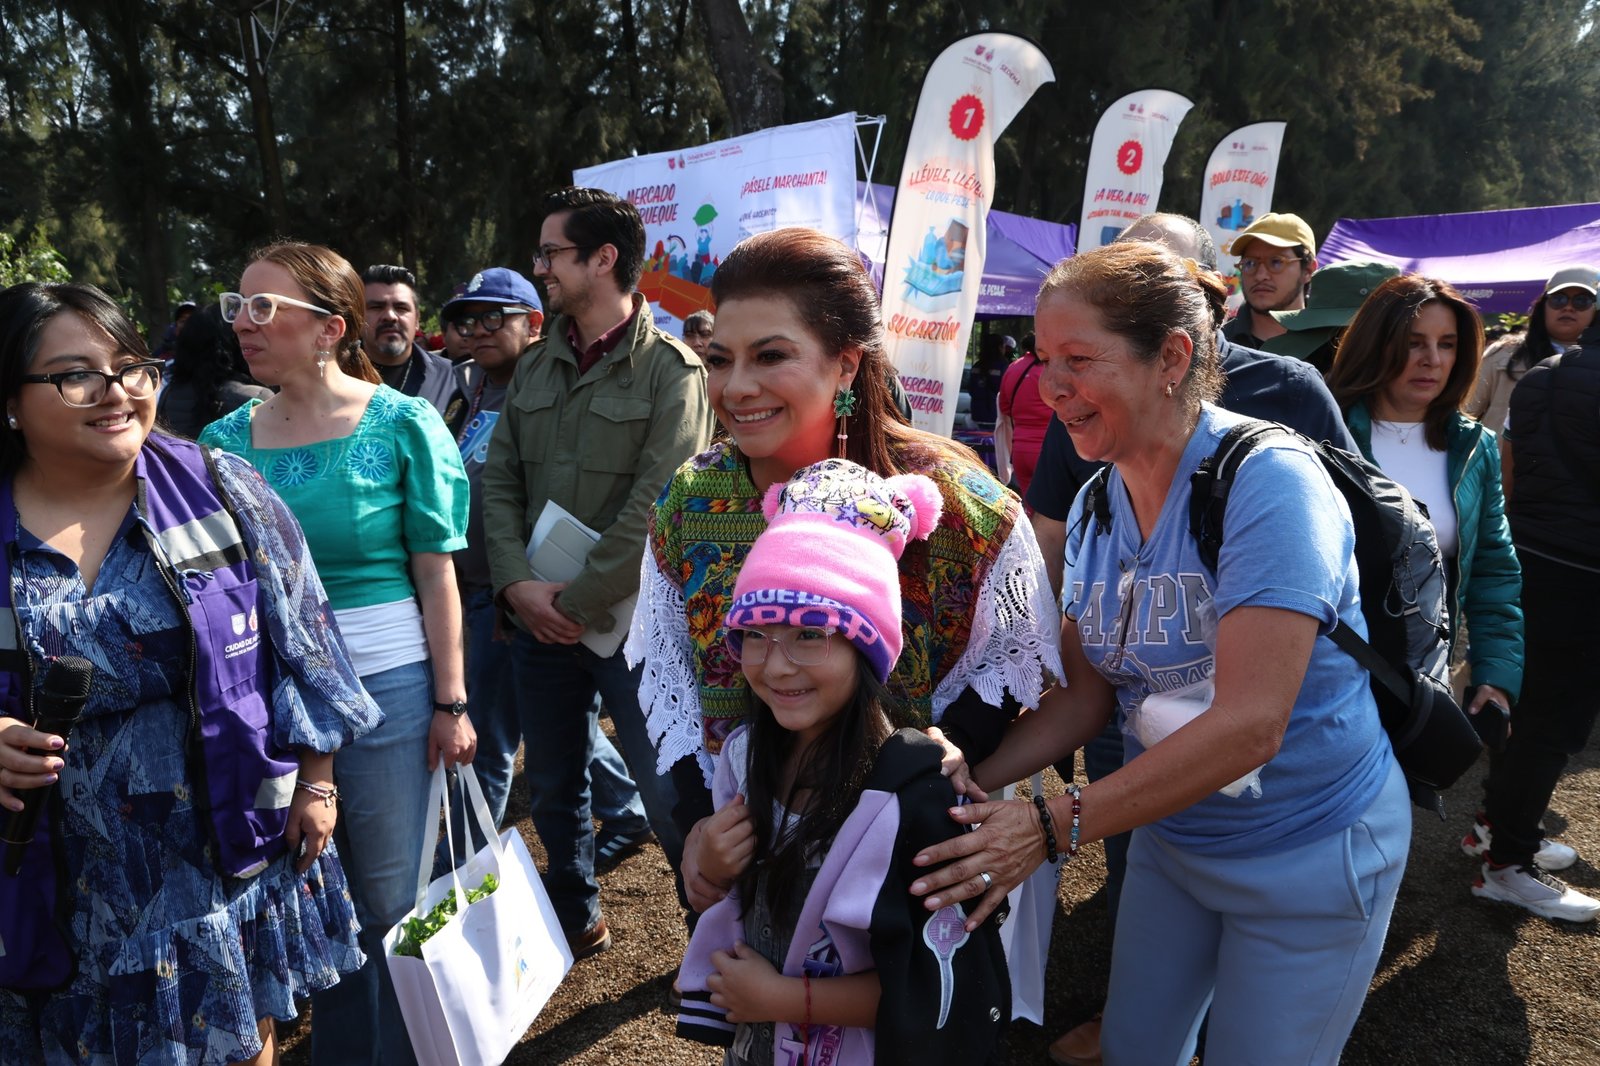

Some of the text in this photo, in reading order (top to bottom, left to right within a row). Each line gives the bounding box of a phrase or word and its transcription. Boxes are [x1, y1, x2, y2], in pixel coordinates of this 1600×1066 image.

[962, 108, 975, 129] 1
[1124, 148, 1137, 166] 2
[771, 169, 828, 190] MARCHANTA!
[626, 183, 676, 206] MERCADO
[888, 312, 961, 341] SU CARTÓN
